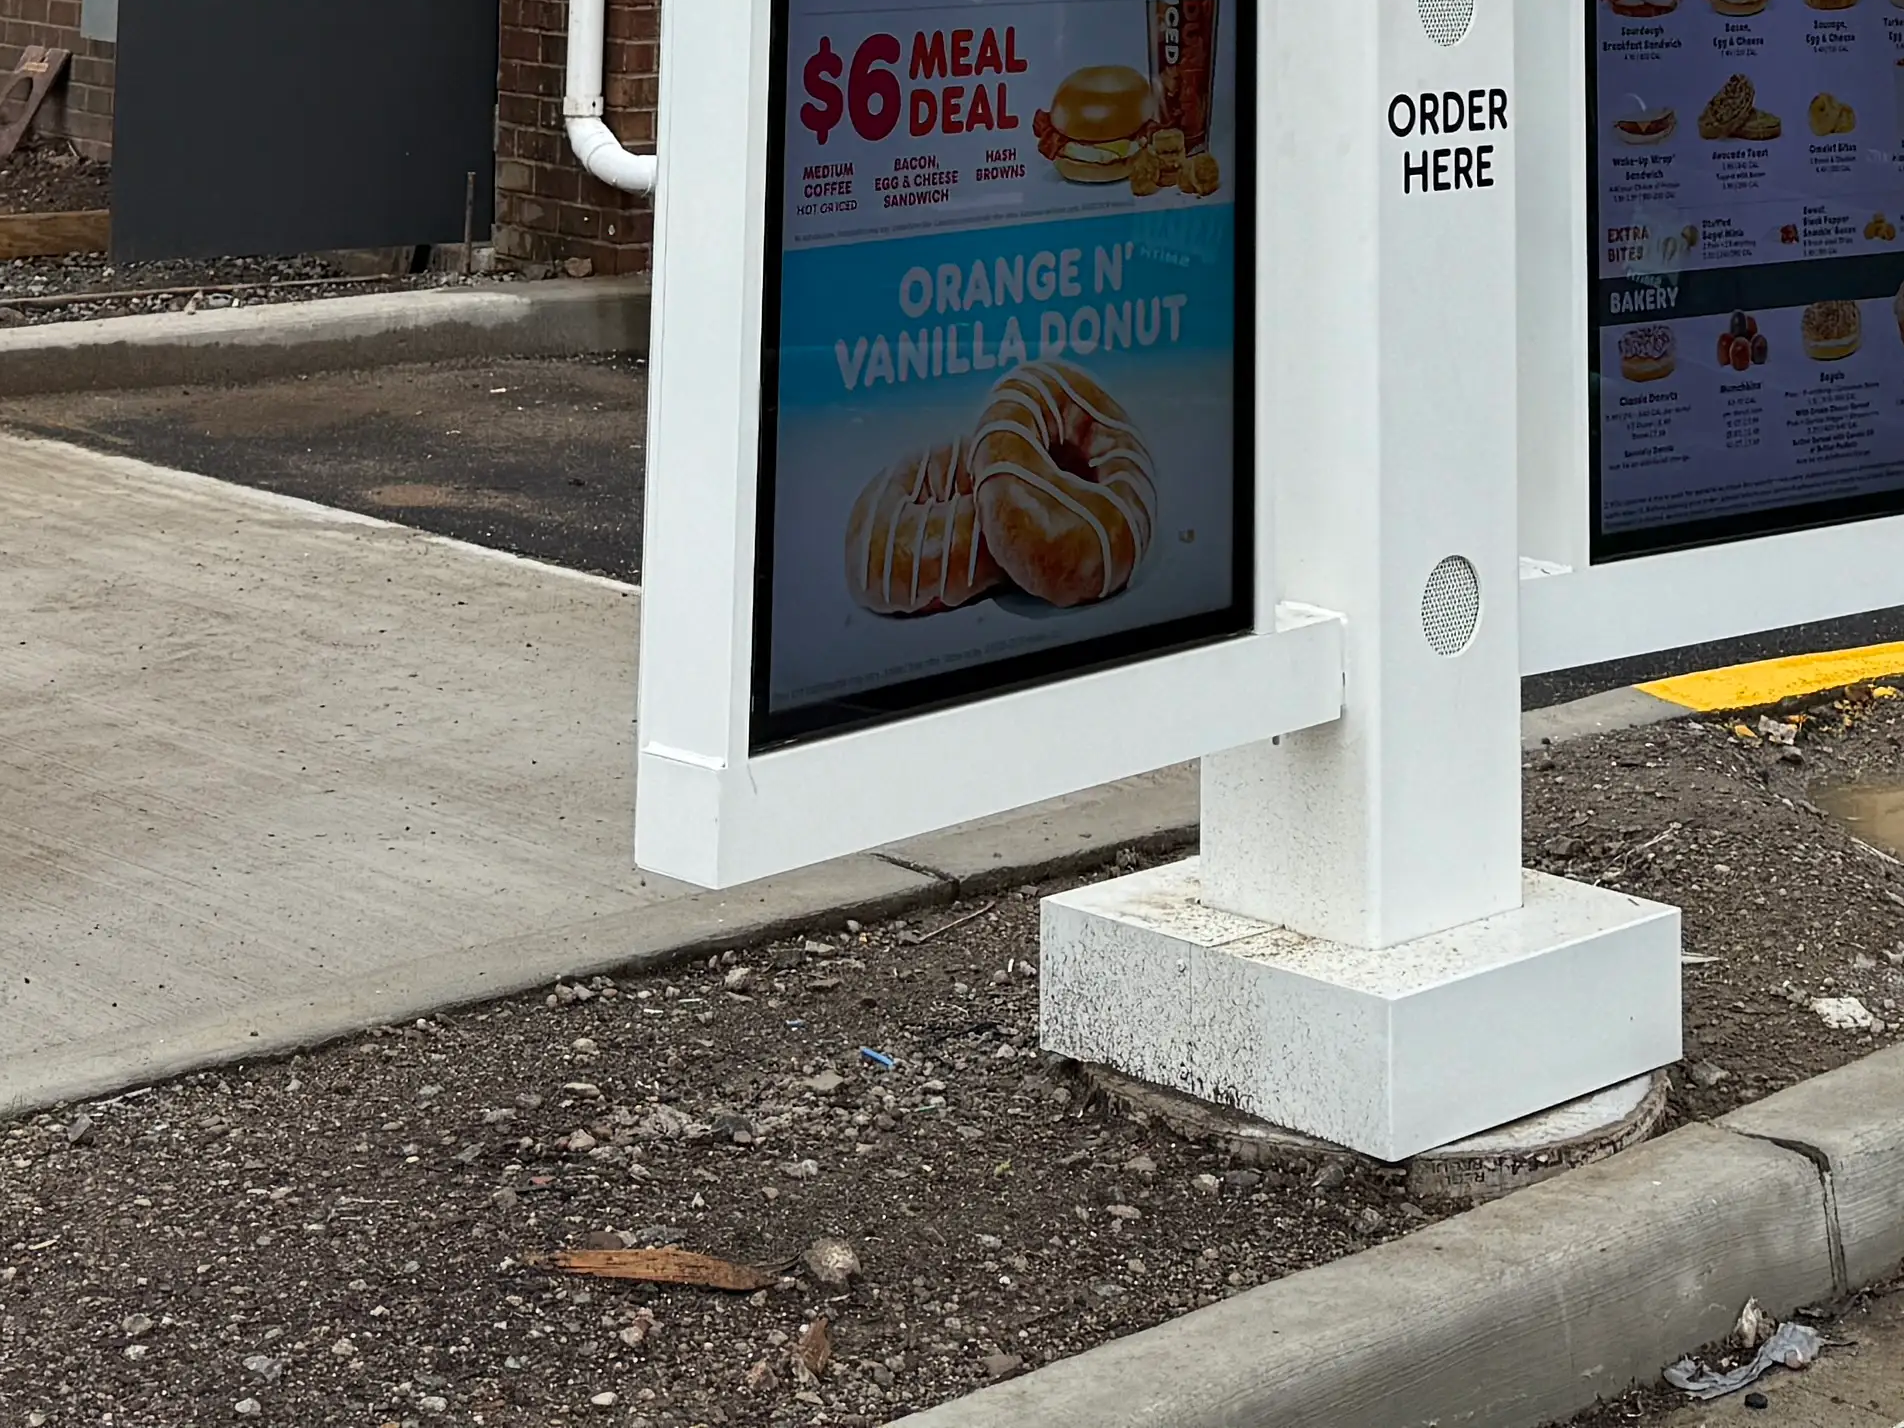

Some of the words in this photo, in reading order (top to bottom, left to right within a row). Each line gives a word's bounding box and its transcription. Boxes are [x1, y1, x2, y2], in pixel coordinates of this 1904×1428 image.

[800, 33, 901, 144] $6
[909, 26, 1027, 81] MEAL
[909, 82, 1018, 137] DEAL
[1388, 89, 1508, 137] ORDER
[894, 155, 939, 171] BACON,
[986, 148, 1016, 163] HASH
[803, 163, 853, 180] MEDIUM
[976, 164, 1025, 181] BROWNS
[1403, 145, 1494, 194] HERE
[804, 181, 852, 198] COFFEE
[875, 177, 898, 192] EGG
[902, 176, 910, 188] &
[914, 171, 959, 186] CHEESE
[884, 189, 949, 208] SANDWICH
[797, 204, 816, 216] HOT
[1608, 226, 1649, 243] EXTRA
[1608, 246, 1643, 262] BITES
[899, 248, 1082, 319] ORANGE
[1095, 242, 1134, 293] N'
[1610, 286, 1678, 313] BAKERY
[835, 316, 1027, 390] VANILLA
[1040, 294, 1187, 357] DONUT
